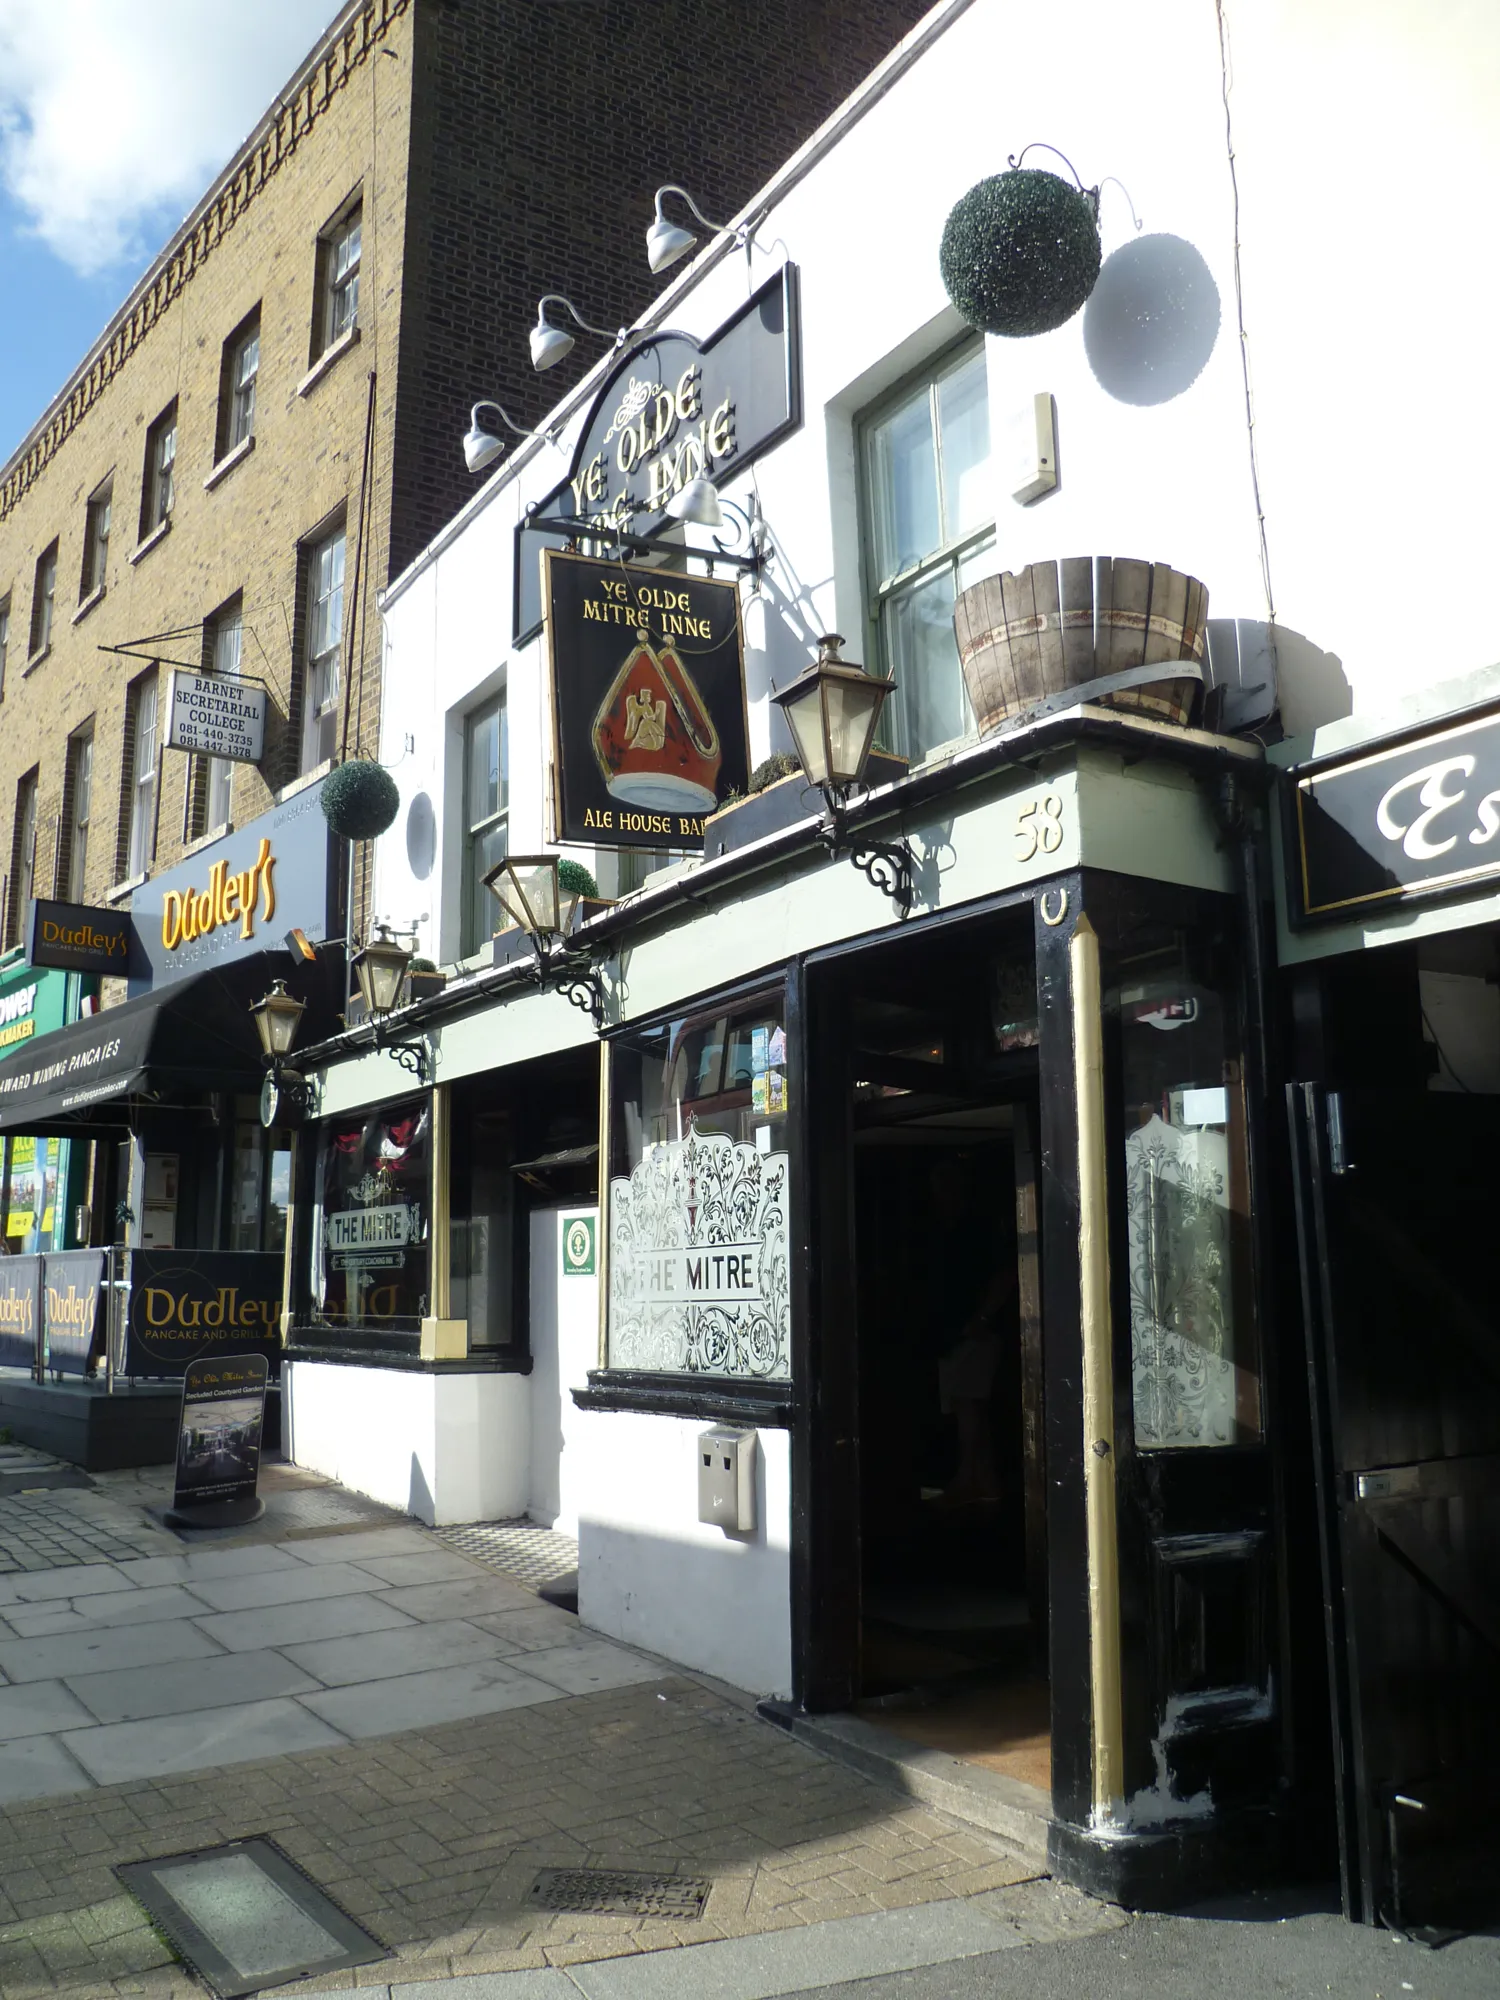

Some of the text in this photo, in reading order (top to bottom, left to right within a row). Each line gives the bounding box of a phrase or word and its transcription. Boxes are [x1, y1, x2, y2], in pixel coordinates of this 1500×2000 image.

[571, 364, 697, 516] YE OLDE
[600, 580, 690, 613] YE OLDE
[583, 599, 711, 639] MITRE INNE
[176, 690, 260, 720] SECRETARIAL
[194, 678, 244, 701] BARNET
[179, 722, 254, 747] 081-440-3735
[189, 709, 246, 732] COLLEGE
[179, 735, 252, 758] 081-447-1378
[583, 808, 613, 828] ALE
[619, 816, 672, 833] HOUSE
[1012, 794, 1064, 863] 58
[162, 838, 276, 950] Dudley's
[42, 920, 128, 957] Dudley's
[335, 1211, 402, 1244] THE MITRE
[638, 1253, 754, 1292] THE MITRE
[48, 1285, 96, 1337] Dudley's
[144, 1329, 261, 1340] PANCAKE AND GRILL
[185, 1385, 264, 1400] Secluded Courtyard Garden
